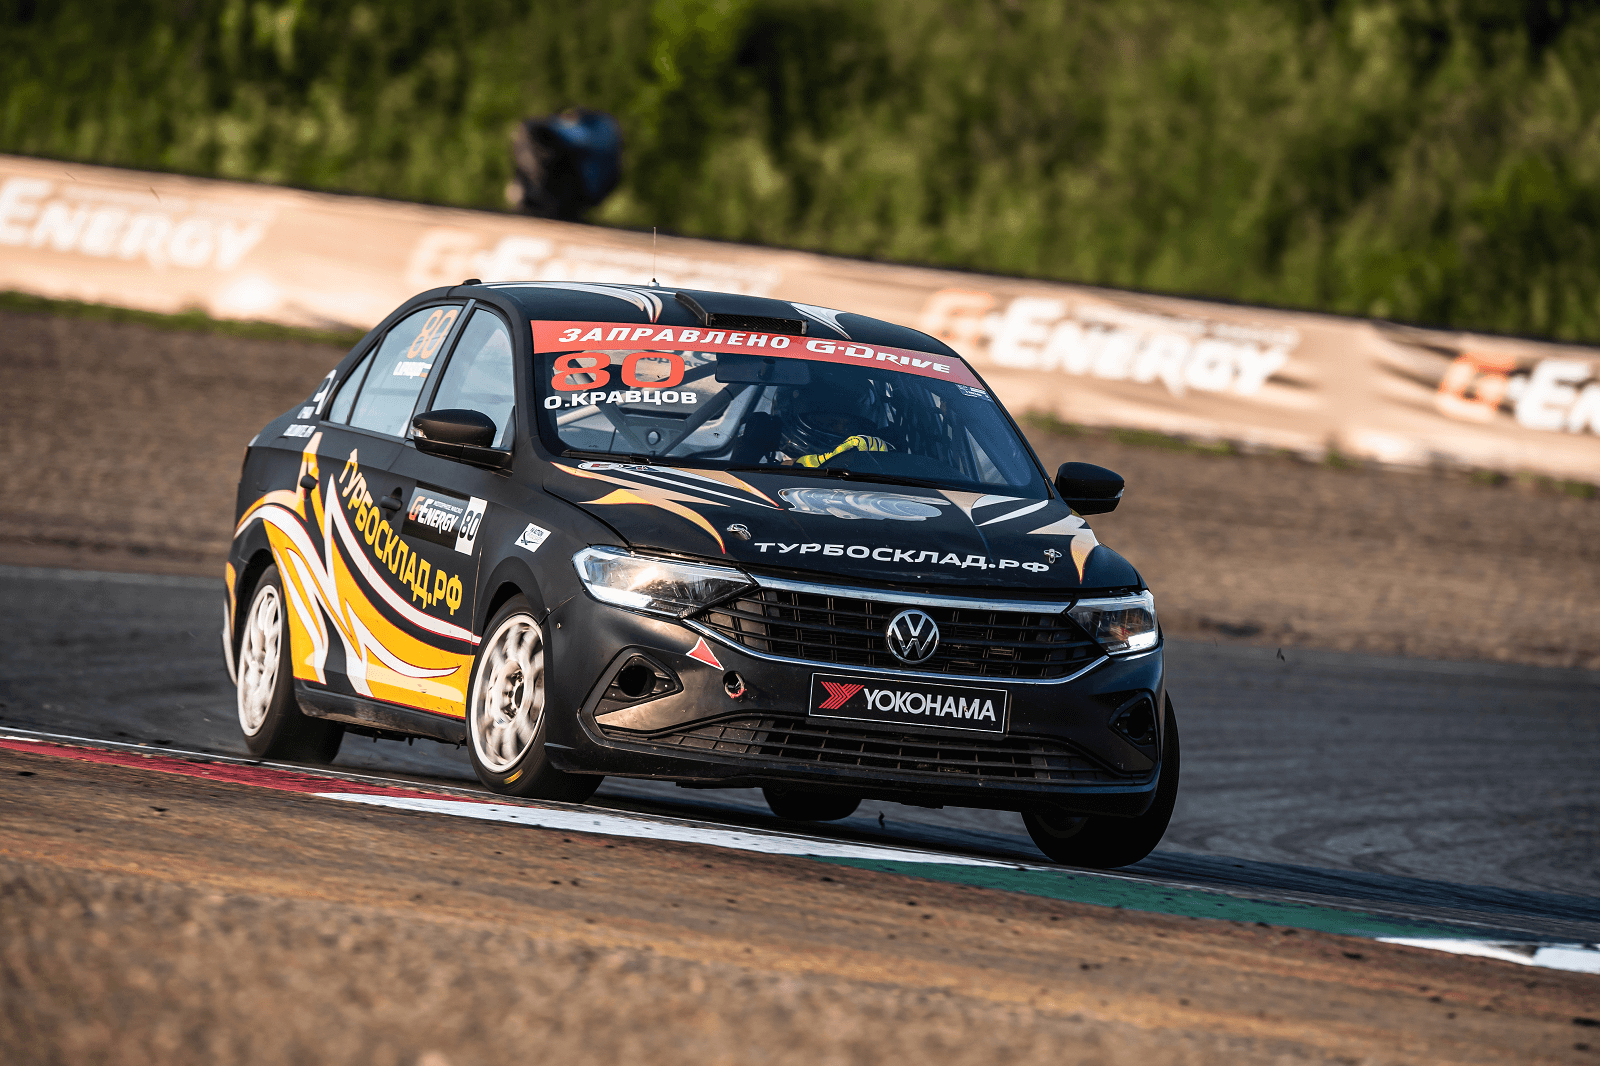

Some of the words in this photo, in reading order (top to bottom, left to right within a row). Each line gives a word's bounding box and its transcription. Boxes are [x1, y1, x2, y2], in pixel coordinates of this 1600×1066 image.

[406, 309, 458, 359] 80
[558, 327, 790, 350] ЗАПРАВЛЕНО
[551, 352, 685, 392] 80
[543, 390, 698, 410] О.КРАВЦОВ
[339, 448, 463, 616] ТУРБОСКЛАД.РФ
[408, 495, 460, 535] G-ENERGY
[458, 510, 483, 542] 80
[753, 542, 1050, 573] ТУРБОСКЛАД.РФ
[863, 688, 997, 722] YOKOHAMA
